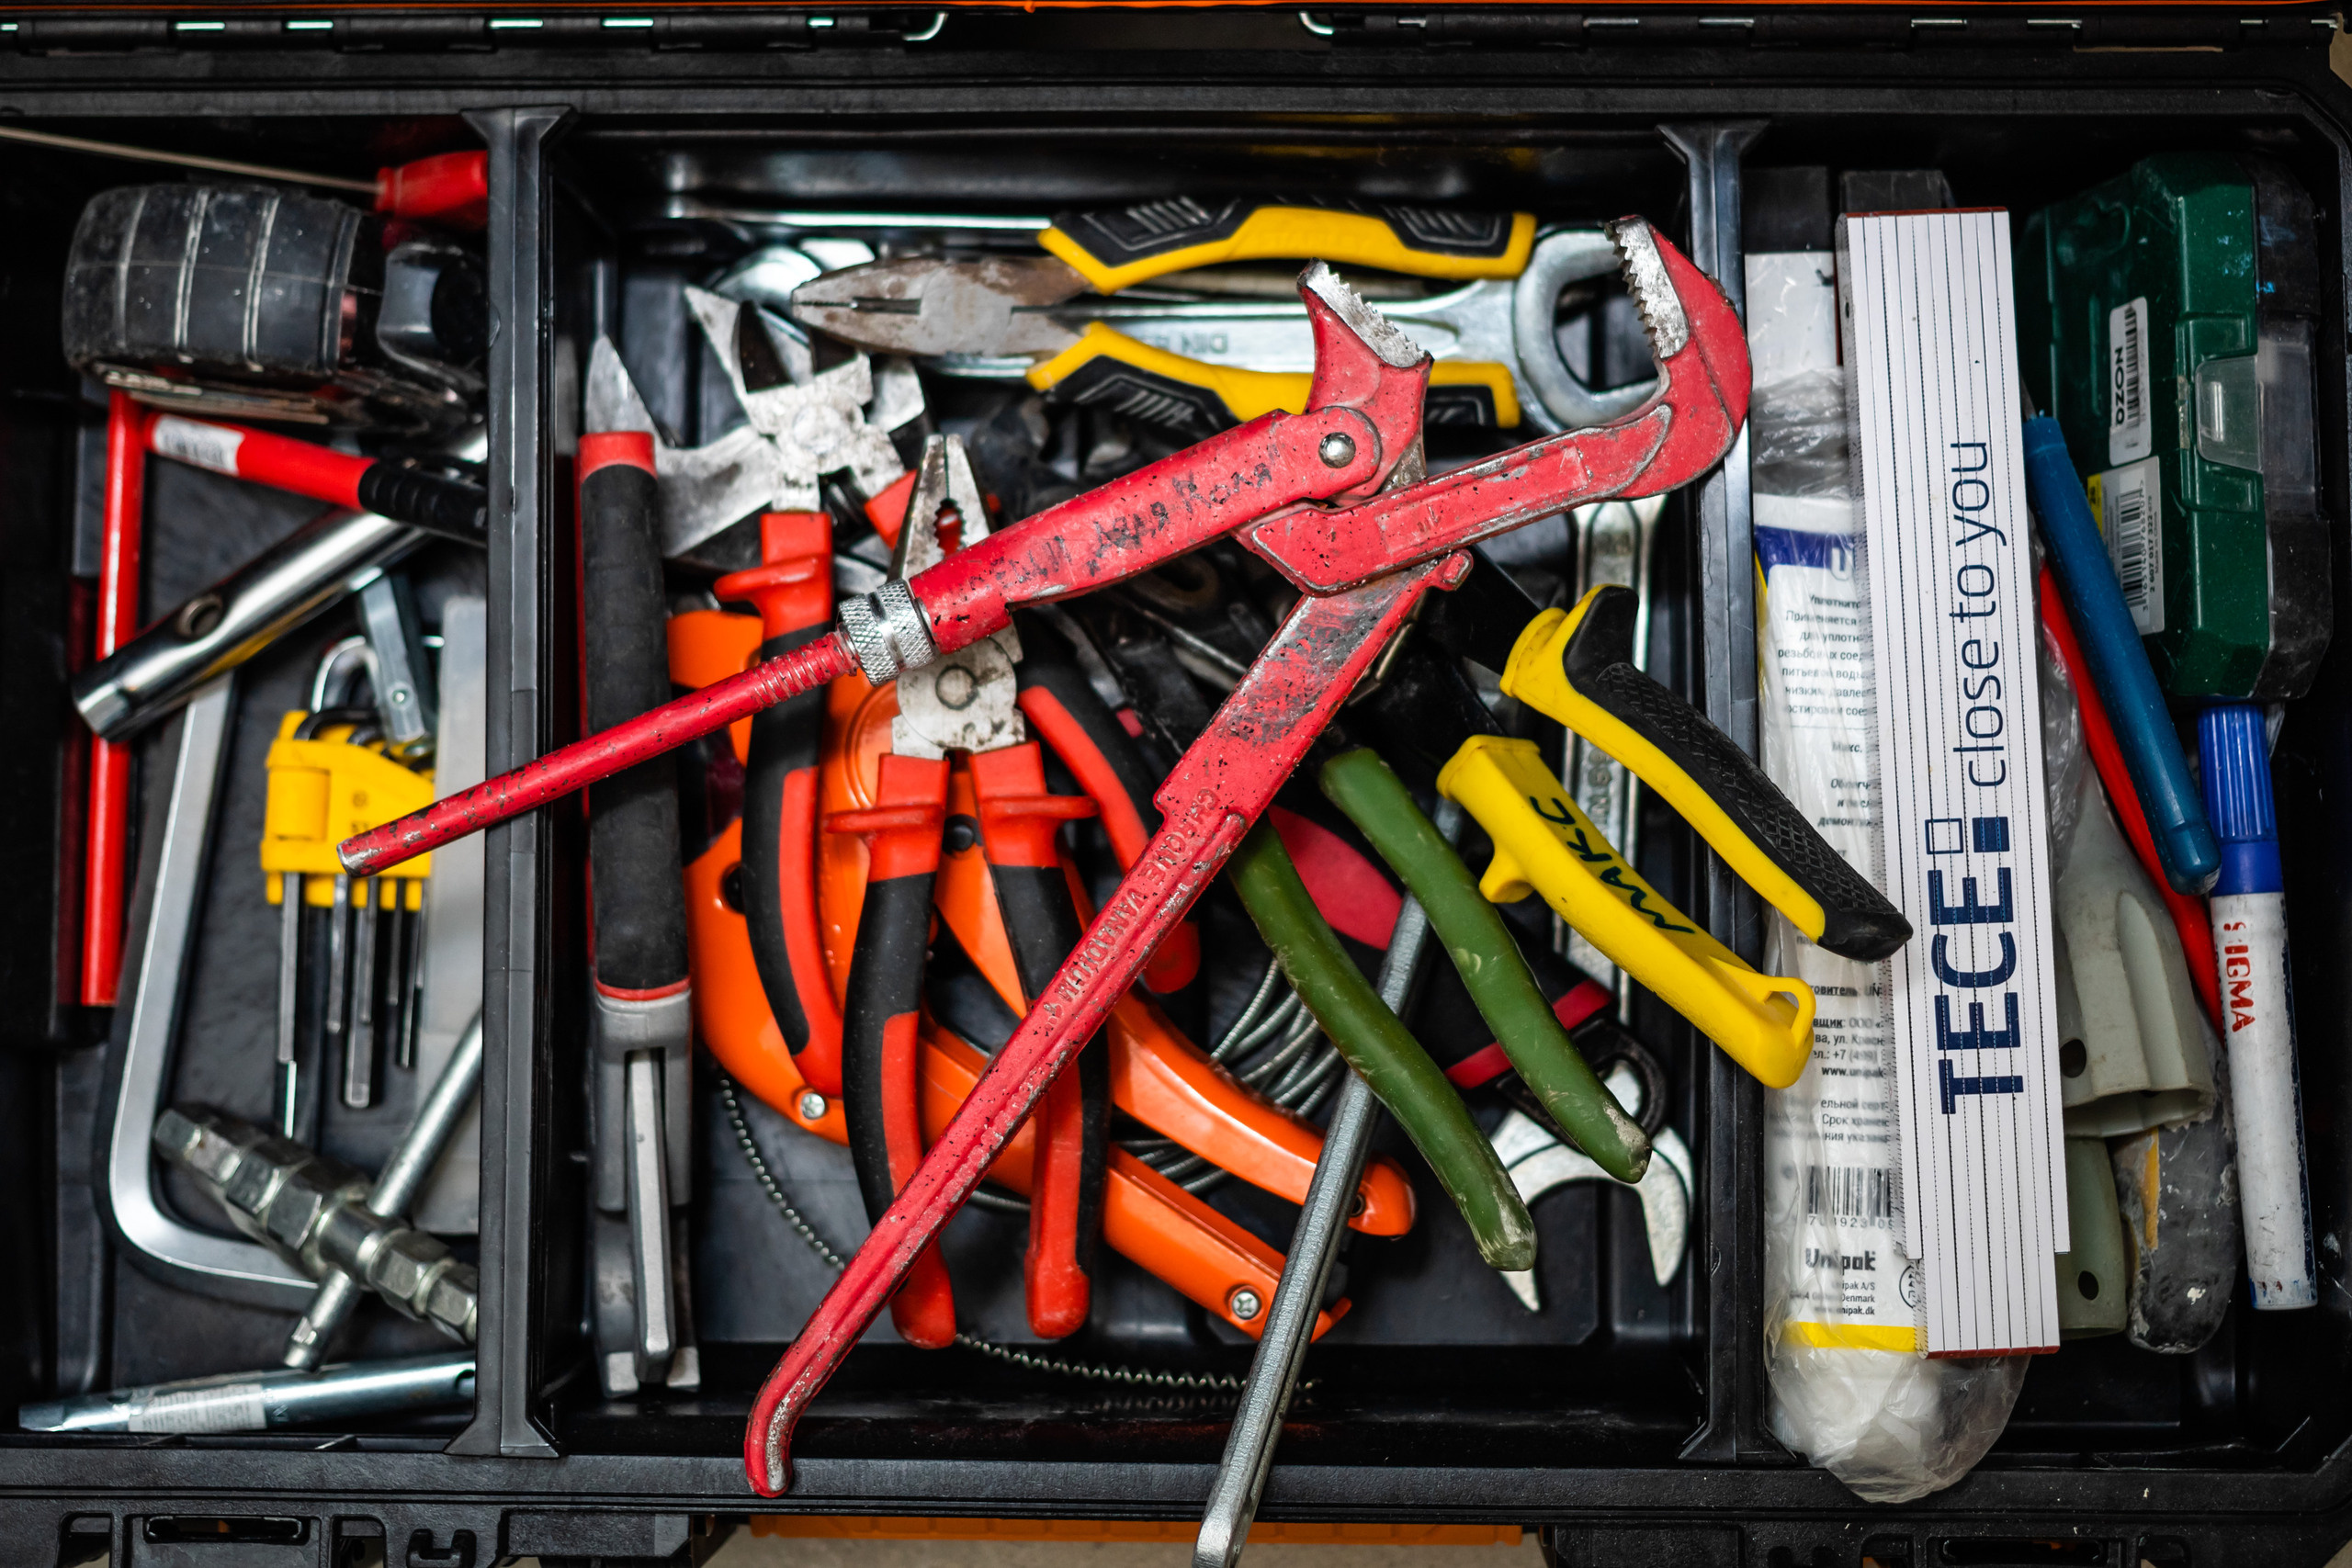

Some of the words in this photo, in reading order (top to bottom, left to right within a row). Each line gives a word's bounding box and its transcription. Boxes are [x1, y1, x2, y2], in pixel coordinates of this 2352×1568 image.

[2114, 346, 2125, 425] OZON
[1949, 443, 2007, 547] you
[1949, 565, 1996, 624] to
[1823, 632, 1860, 644] уплотн
[1840, 651, 1861, 662] сое
[1845, 706, 1867, 717] сое
[1953, 639, 2007, 788] close
[1055, 887, 1148, 1003] VANADIUM
[1928, 867, 2024, 1116] TECE
[1813, 1018, 1846, 1029] вщик:
[1815, 1033, 1831, 1044] ва,
[1822, 1113, 1849, 1126] Срок
[1825, 1132, 1844, 1142] ния
[1860, 1281, 1876, 1292] A/S
